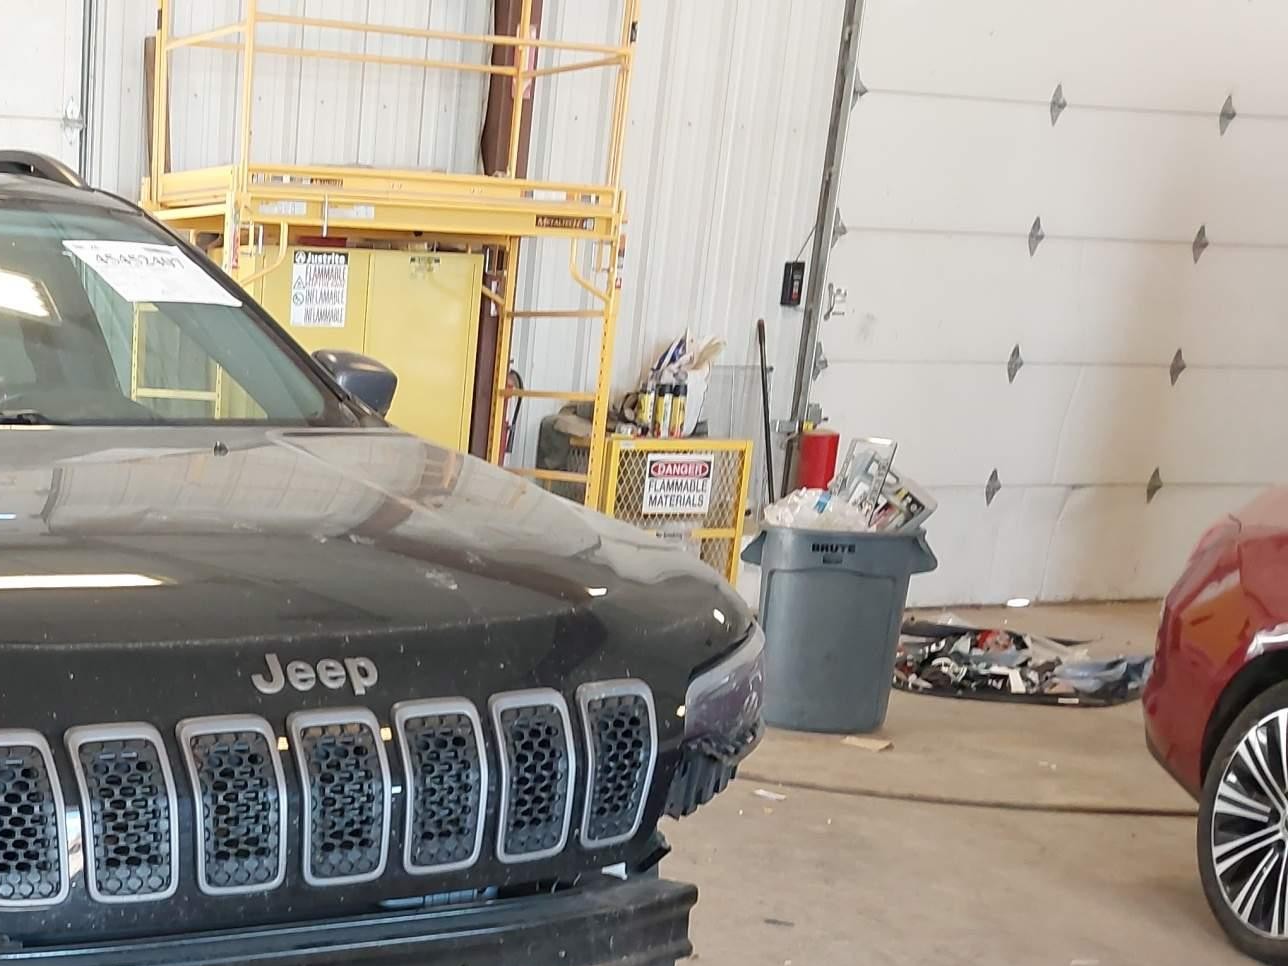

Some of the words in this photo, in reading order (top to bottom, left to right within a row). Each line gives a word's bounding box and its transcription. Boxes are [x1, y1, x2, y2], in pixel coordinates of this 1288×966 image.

[658, 462, 704, 476] DANGER
[648, 479, 707, 492] FLAMMABLE
[648, 494, 705, 507] MATERIALS
[812, 543, 855, 553] BRUTE
[251, 653, 379, 696] Jeep
